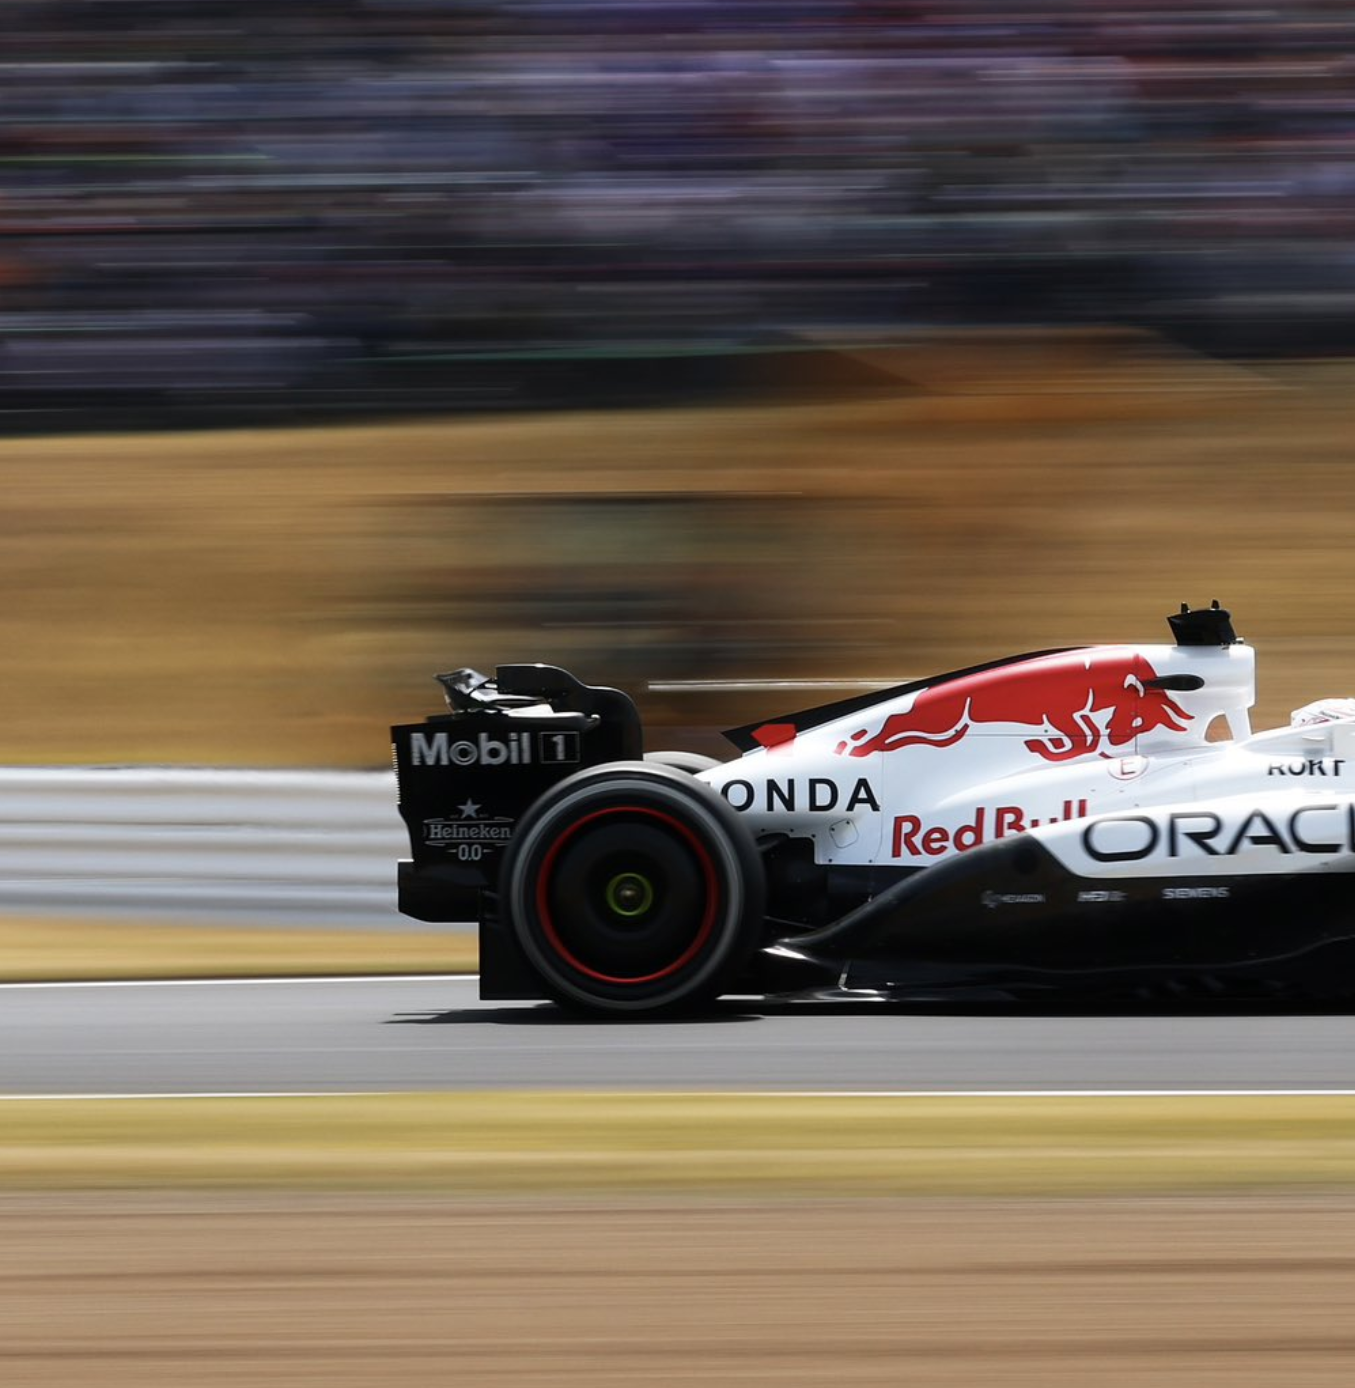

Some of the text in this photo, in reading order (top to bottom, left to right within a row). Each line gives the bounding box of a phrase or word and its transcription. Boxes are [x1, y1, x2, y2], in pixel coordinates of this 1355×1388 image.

[410, 732, 565, 766] Mobil 1
[705, 778, 881, 812] ONDA
[429, 824, 514, 838] Heineken
[891, 806, 985, 858] Red
